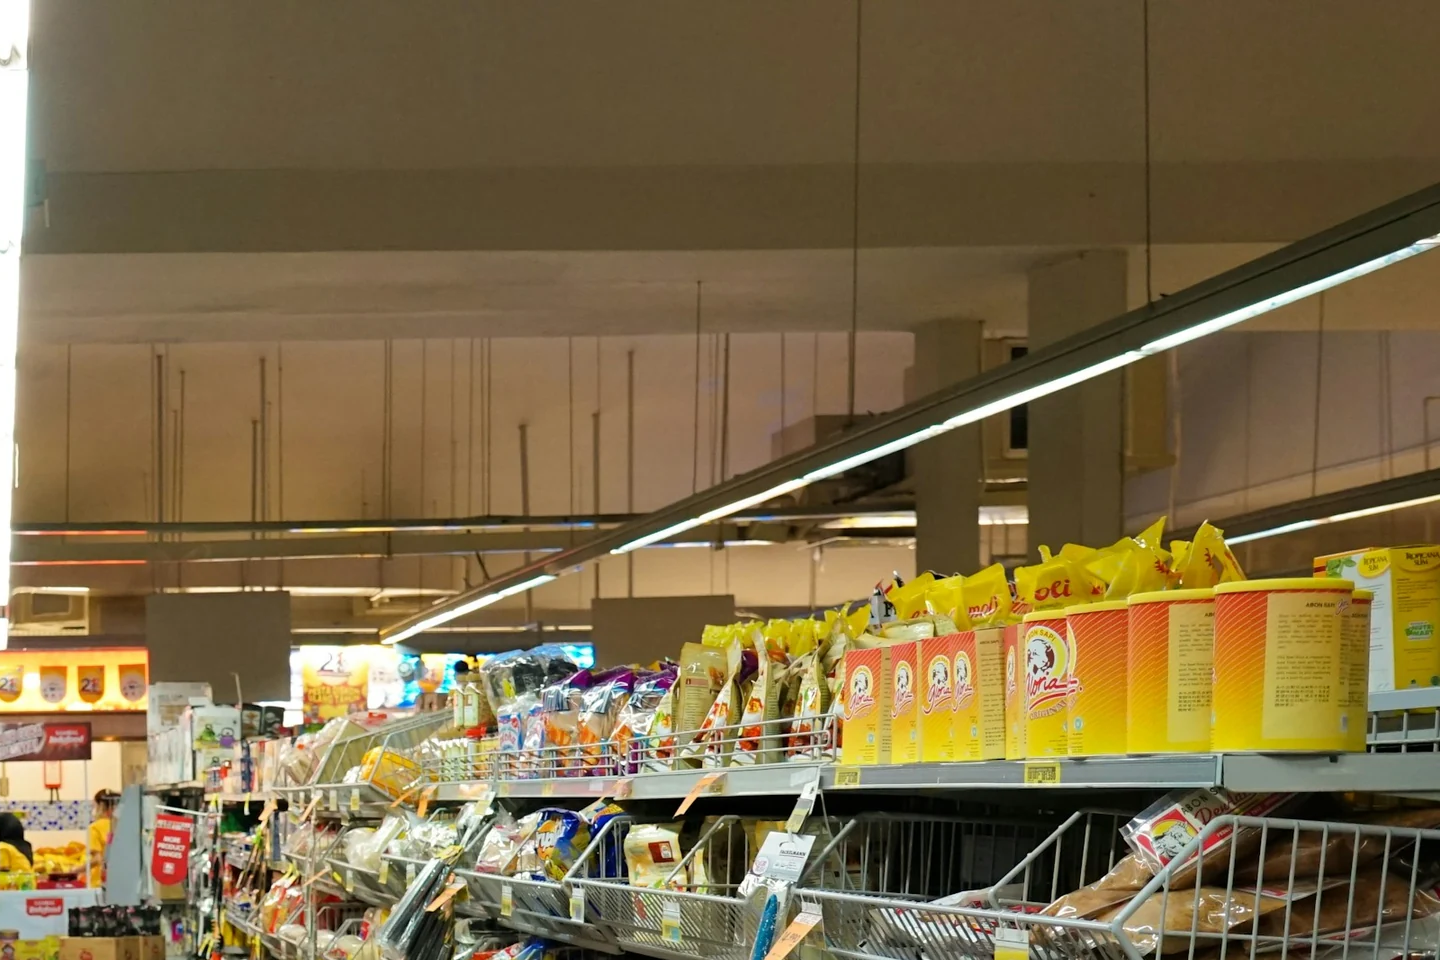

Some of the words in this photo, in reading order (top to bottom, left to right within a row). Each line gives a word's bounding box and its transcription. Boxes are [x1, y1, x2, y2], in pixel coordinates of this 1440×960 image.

[1405, 551, 1440, 560] TROPICANA
[1363, 555, 1388, 566] TROPICANA
[163, 836, 181, 844] MORE
[157, 842, 186, 851] PRODUCT
[158, 850, 183, 859] RANGES
